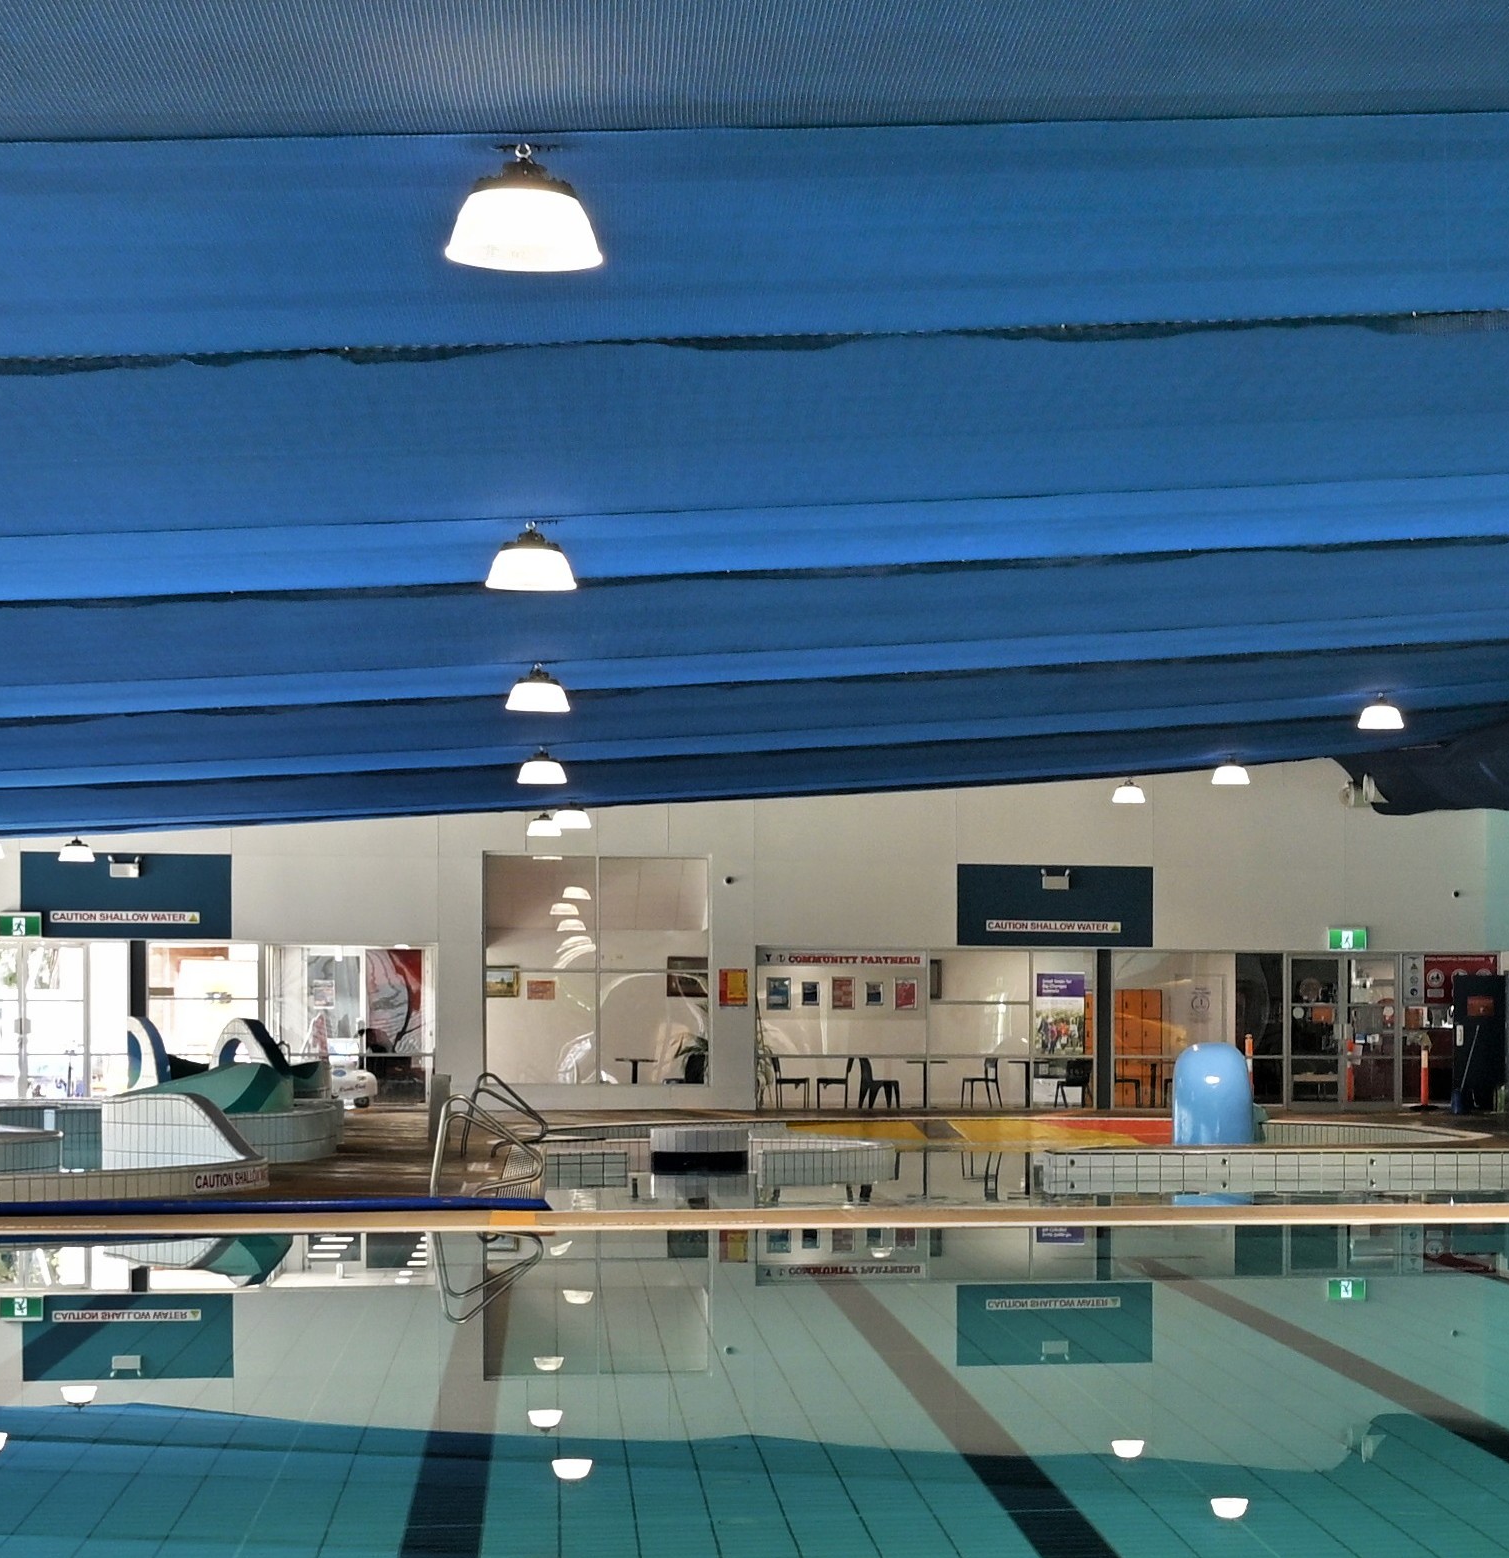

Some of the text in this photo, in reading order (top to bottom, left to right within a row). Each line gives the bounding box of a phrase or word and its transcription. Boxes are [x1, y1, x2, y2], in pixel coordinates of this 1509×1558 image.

[52, 913, 186, 922] CAUTION SHALLOW WATER
[988, 921, 1108, 931] CAUTION SHALLOW WATER
[788, 955, 858, 964] COMMUNITY
[861, 956, 921, 965] PARTNERS
[195, 1172, 233, 1189] CAUTION
